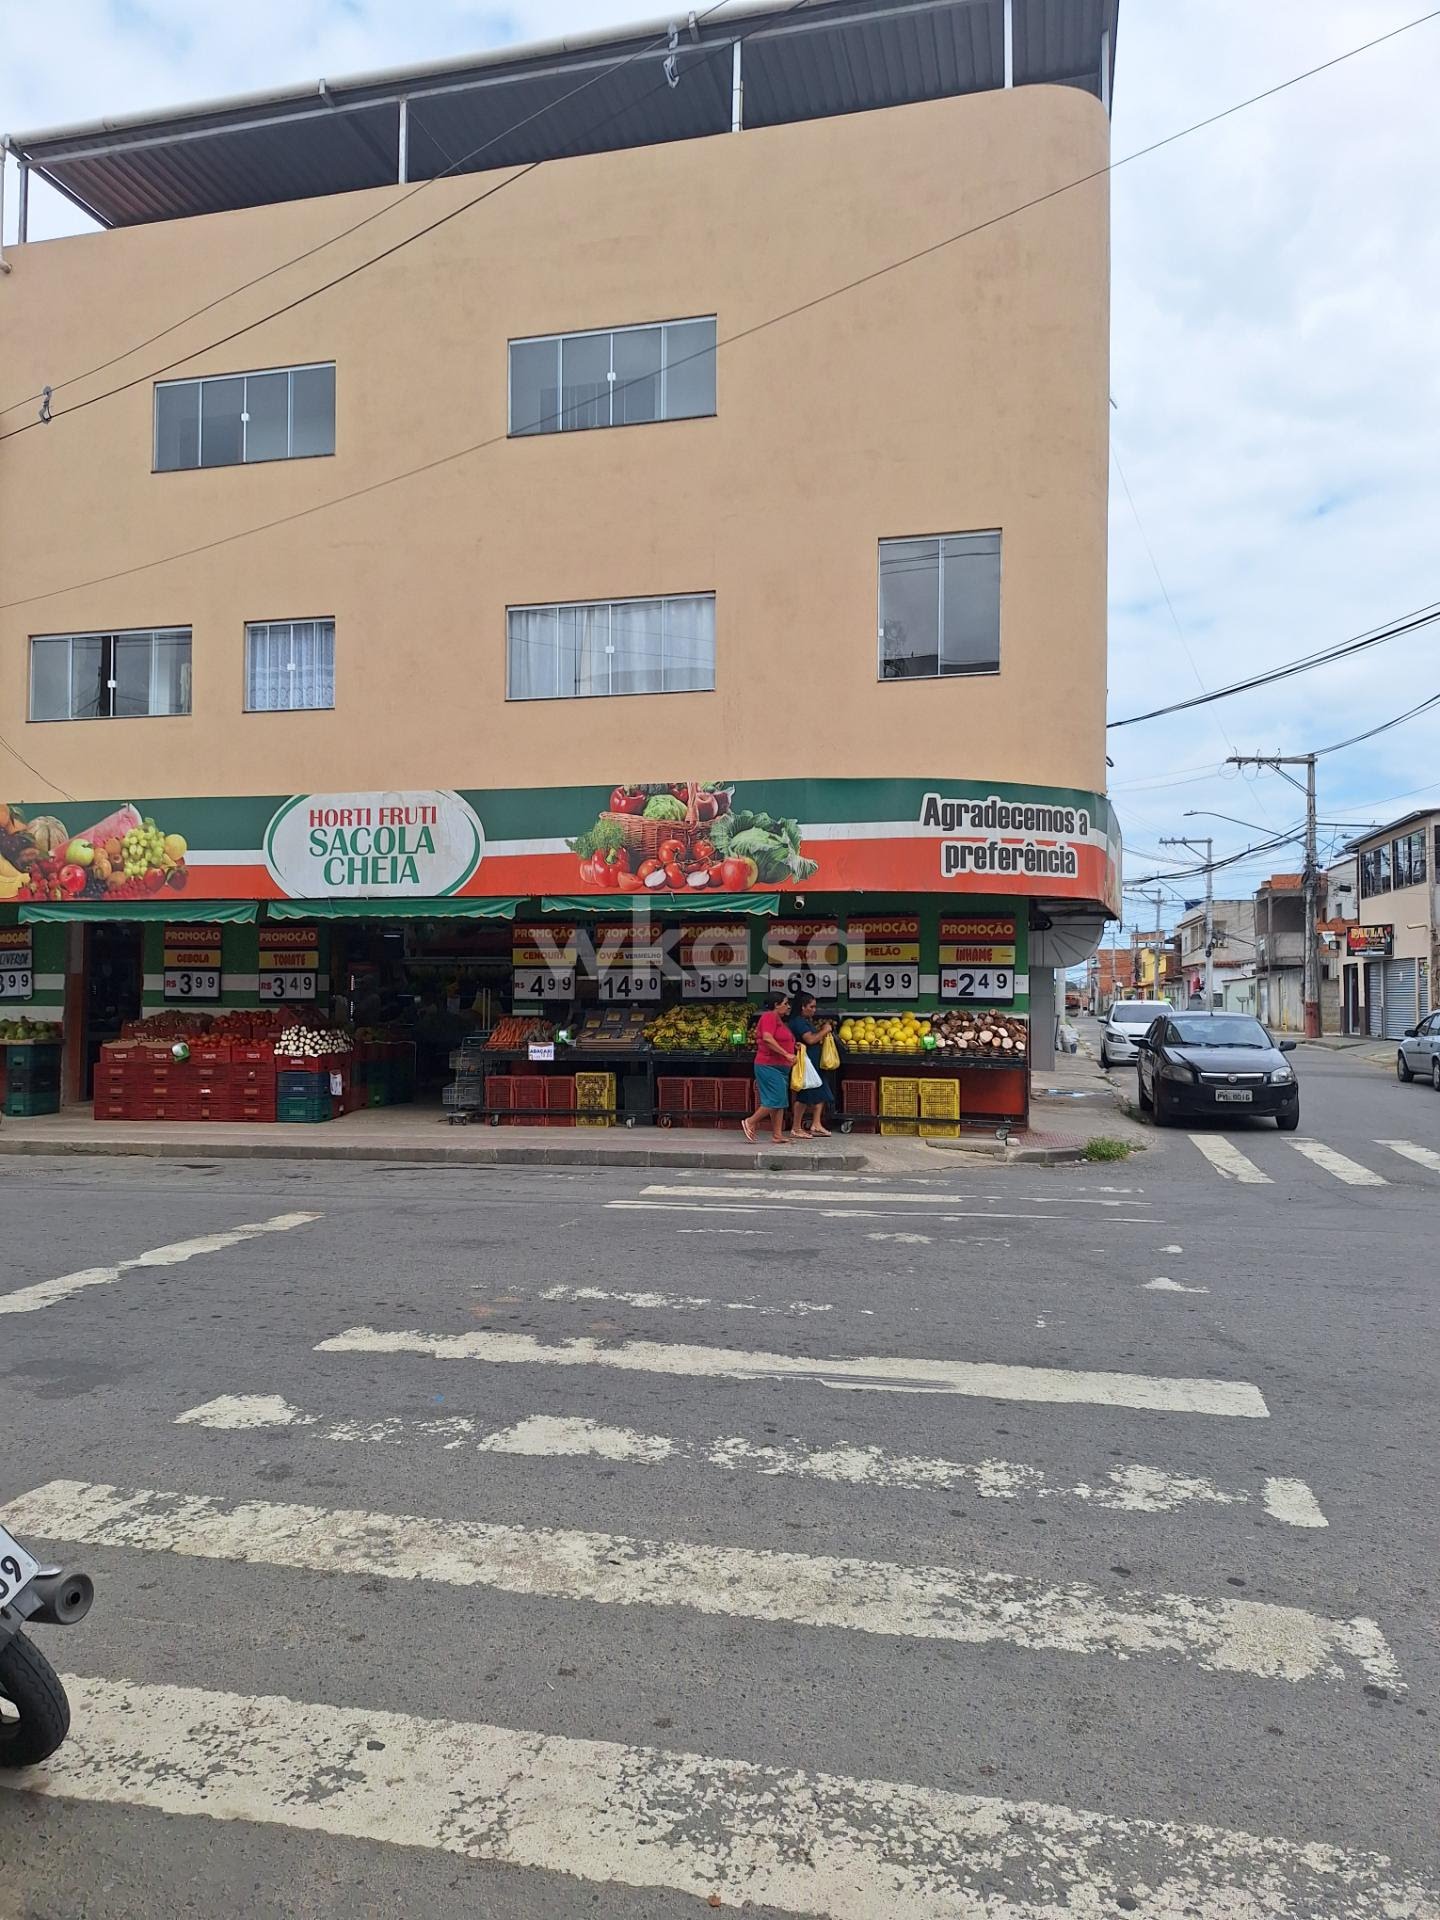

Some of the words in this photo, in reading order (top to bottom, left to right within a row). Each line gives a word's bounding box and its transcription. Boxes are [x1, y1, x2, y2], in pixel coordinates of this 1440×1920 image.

[309, 808, 371, 827] HORTI
[379, 806, 436, 826] FRUTI
[923, 797, 1075, 834] Agradecemos
[1079, 811, 1089, 836] a
[309, 826, 435, 857] SACOLA
[945, 841, 1076, 874] preferência
[323, 856, 420, 886] CHEIA
[514, 927, 576, 939] PROMOÇÃO
[597, 926, 661, 939] PROMOÇÃO
[770, 924, 837, 937] PROMOÇÃO
[849, 920, 918, 934] PROMOÇÃO
[942, 922, 1014, 936] PROMOÇÃO
[165, 929, 221, 942] PROMOÇÃO
[259, 930, 316, 942] PROMOÇÃO
[523, 951, 566, 960] CENOURA
[600, 951, 624, 960] OVOS
[865, 946, 901, 956] MELÃO
[956, 948, 993, 962] INHAME
[176, 953, 209, 964] CEBOLA
[273, 953, 306, 967] TOMATE
